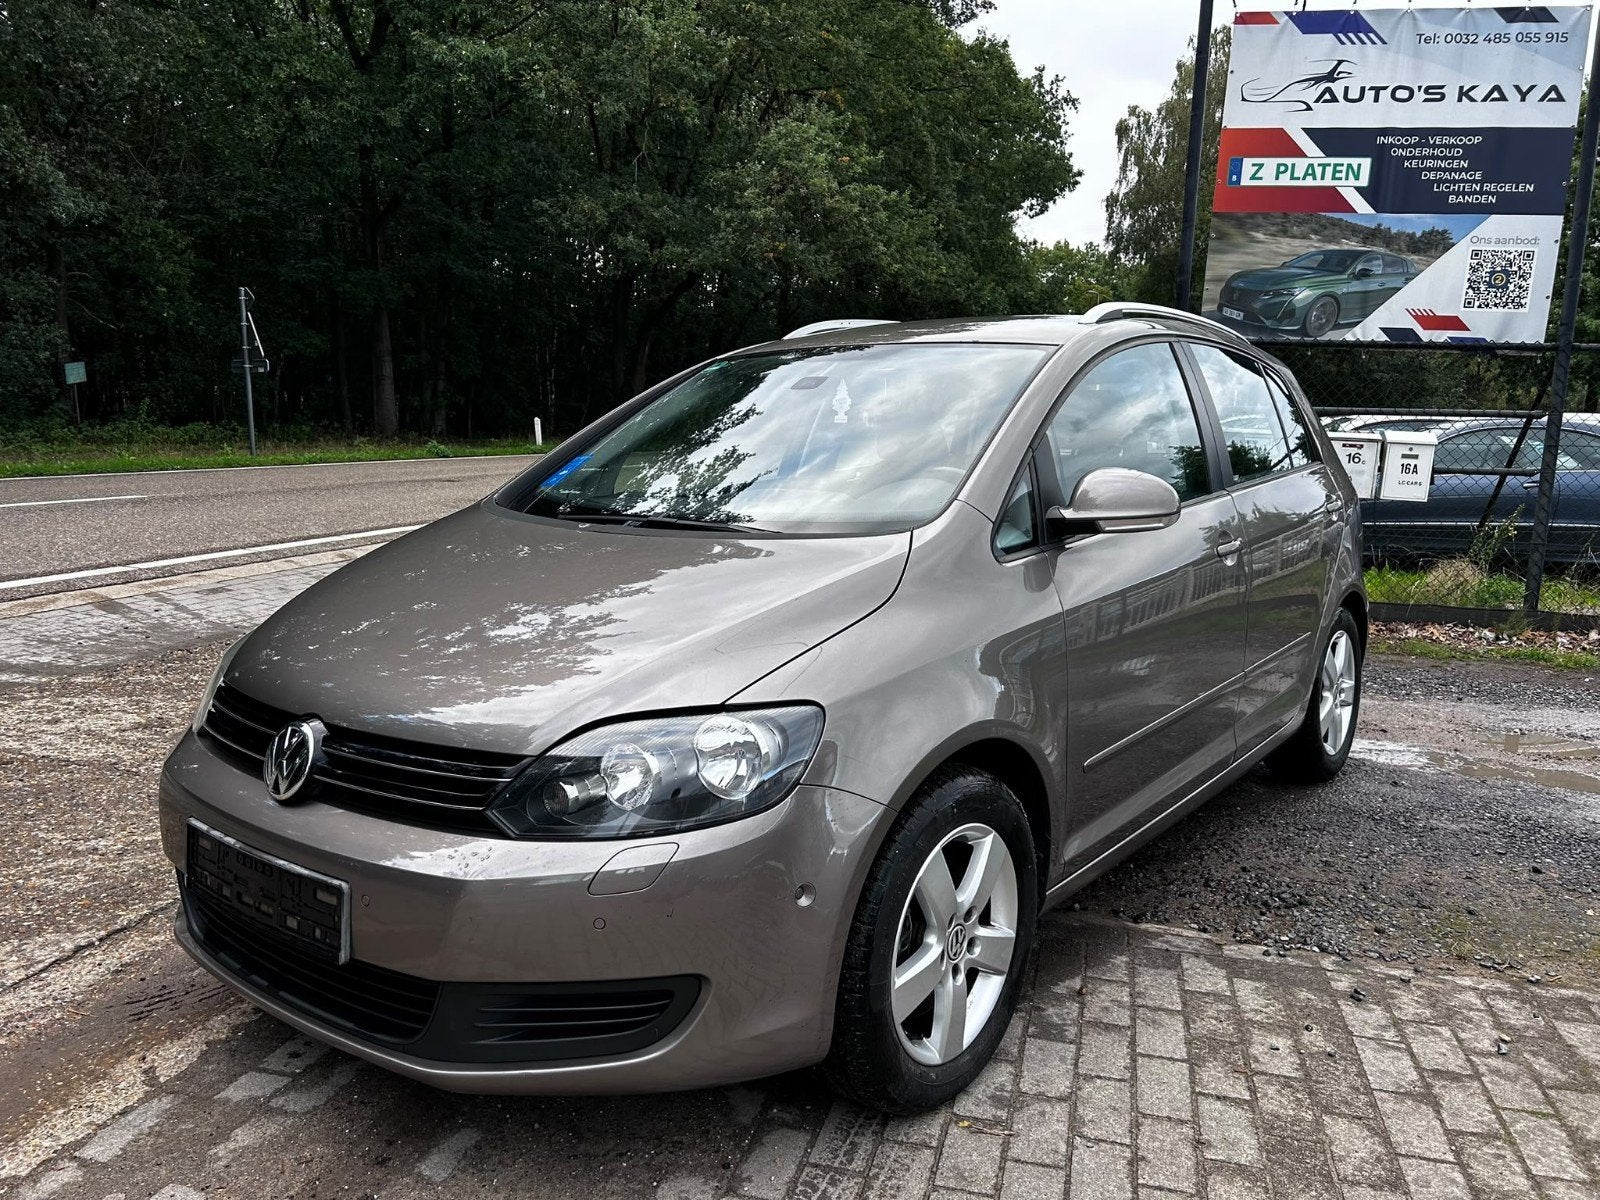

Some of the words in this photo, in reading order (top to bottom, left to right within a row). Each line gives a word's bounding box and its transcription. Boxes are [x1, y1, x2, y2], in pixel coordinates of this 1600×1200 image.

[1416, 33, 1440, 44] Tel:
[1444, 33, 1479, 44] 0032
[1482, 32, 1511, 44] 485
[1515, 32, 1541, 43] 055
[1545, 31, 1569, 43] 915
[1313, 84, 1447, 103] AUTO'S
[1456, 84, 1567, 103] KAYA
[1376, 136, 1419, 145] INKOOP
[1428, 136, 1482, 145] VERKOOP
[1390, 148, 1463, 157] ONDERHOUD
[1403, 159, 1469, 168] KEURINGEN
[1249, 163, 1265, 181] Z
[1274, 162, 1362, 181] PLATEN
[1421, 171, 1483, 180] DEPANAGE
[1433, 183, 1481, 192] LICHTEN
[1483, 183, 1534, 192] REGELEN
[1448, 194, 1497, 203] BANDEN
[1470, 235, 1493, 245] Ons
[1494, 235, 1540, 246] aanbod:
[1400, 463, 1418, 475] 16A
